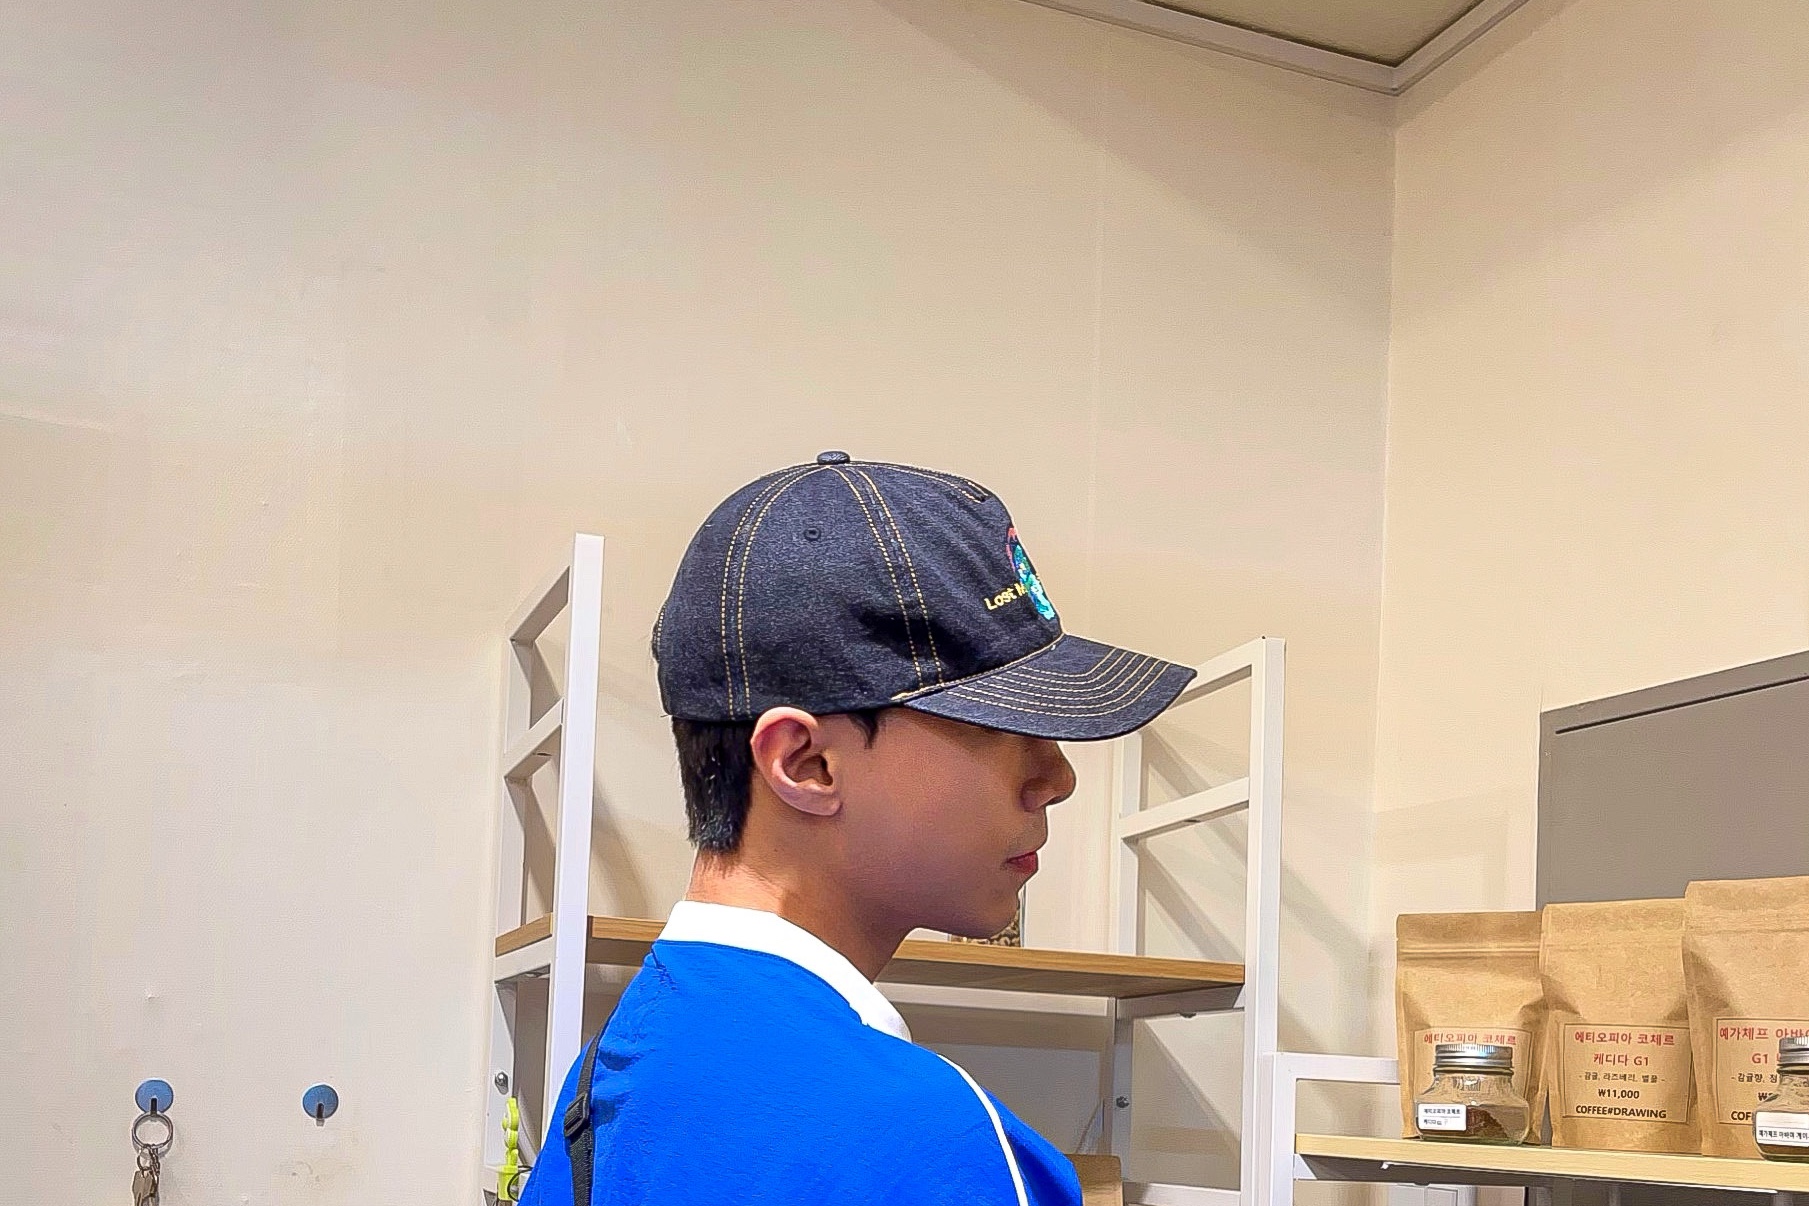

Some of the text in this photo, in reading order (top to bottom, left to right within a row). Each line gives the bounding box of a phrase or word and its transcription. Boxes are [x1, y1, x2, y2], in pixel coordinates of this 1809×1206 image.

[1575, 1031, 1675, 1046] 에티오피아 코체르
[1720, 1027, 1769, 1040] 예가체프
[1593, 1053, 1649, 1066] 케디다 G1
[1751, 1053, 1769, 1064] G1
[1575, 1105, 1667, 1118] COFFEE#DRAWING
